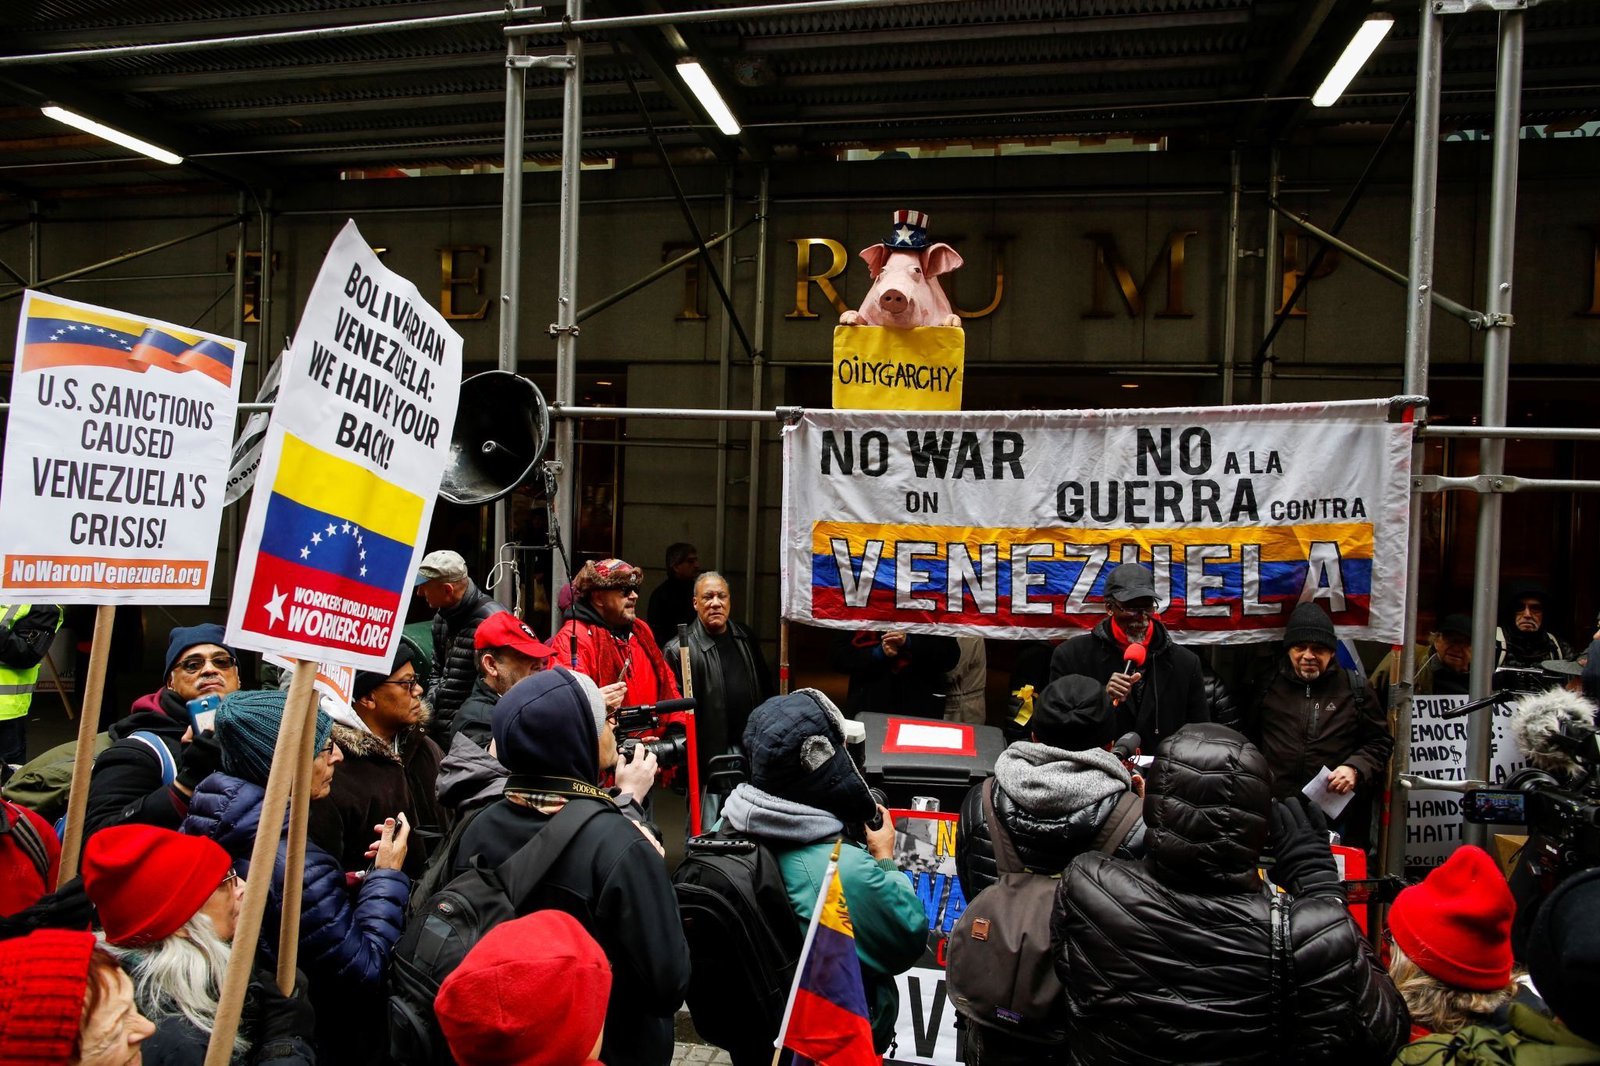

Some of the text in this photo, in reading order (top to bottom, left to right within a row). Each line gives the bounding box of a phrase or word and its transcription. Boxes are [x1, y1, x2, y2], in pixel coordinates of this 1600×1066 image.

[226, 245, 491, 323] TE
[344, 262, 445, 366] BOLIVARIAN
[334, 306, 435, 403] VENEZUELA:
[38, 373, 214, 431] U.S. SANCTIONS
[308, 341, 439, 449] WE HAVE YOUR
[81, 419, 174, 459] CAUSED
[335, 412, 395, 470] BACK!
[820, 430, 1025, 480] NO WAR
[1136, 426, 1213, 476] NO
[33, 457, 207, 509] VENEZUELA'S
[905, 490, 938, 513] ON
[1056, 478, 1367, 523] GUERRA CONTRA
[70, 512, 167, 549] CRISIS!
[11, 559, 202, 586] NoWaronVenezuela.org
[829, 537, 1347, 617] VENEZUELA
[287, 605, 390, 649] WORKERS.ORG
[293, 586, 394, 624] WORKERS WORLD PARTY
[1407, 822, 1463, 843] HAITI
